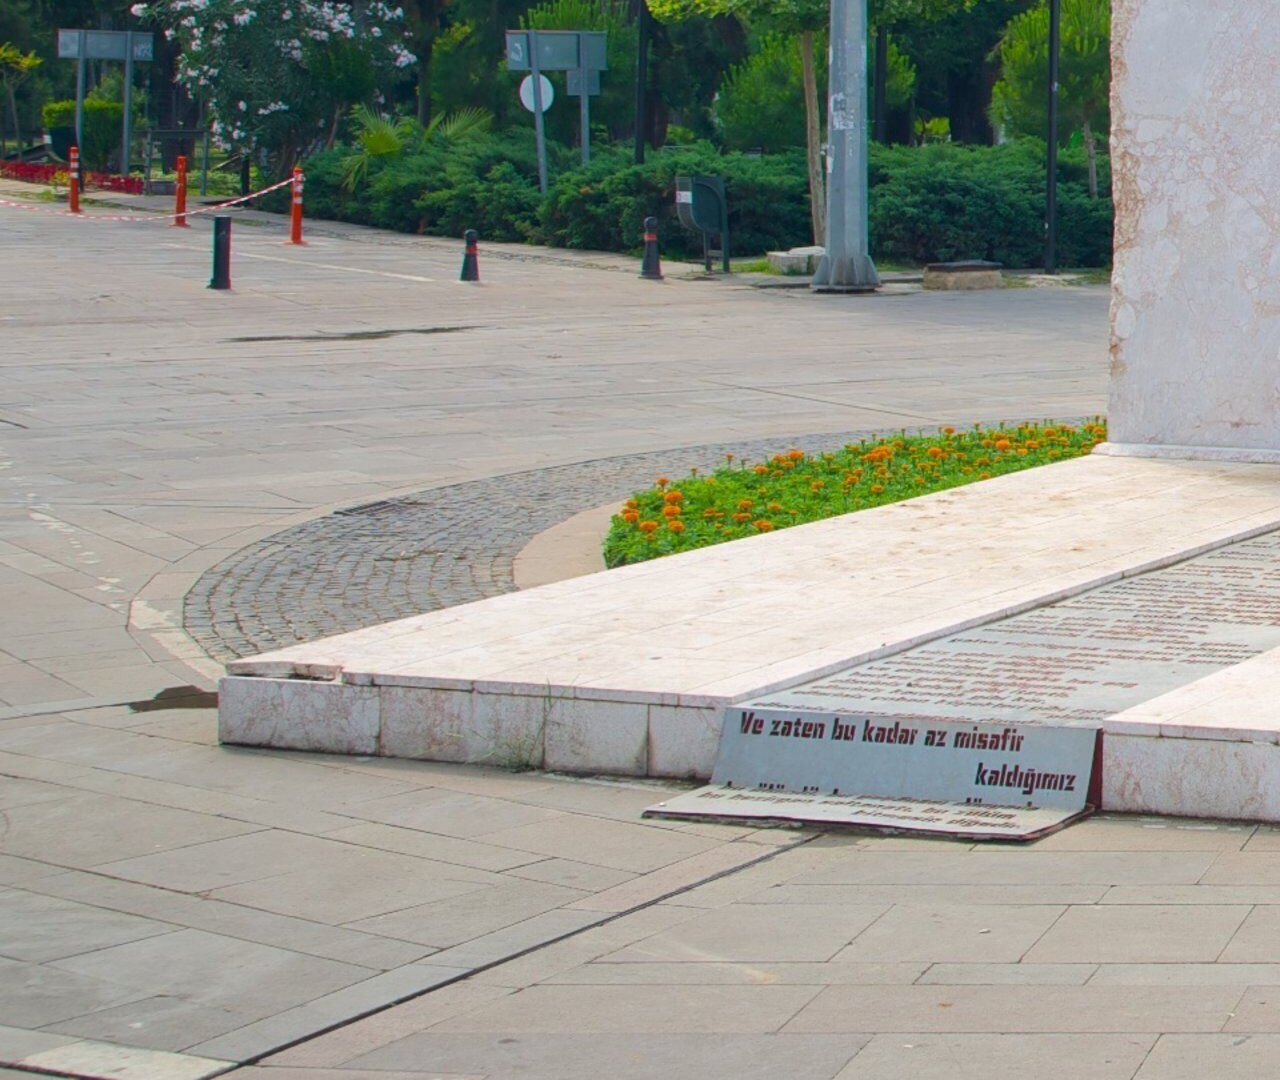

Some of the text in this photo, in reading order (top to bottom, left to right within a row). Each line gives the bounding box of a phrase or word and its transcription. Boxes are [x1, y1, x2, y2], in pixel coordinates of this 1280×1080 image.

[740, 712, 1025, 752] Ve zaten bu kadar az misafir
[975, 762, 1077, 795] kaldığımız
